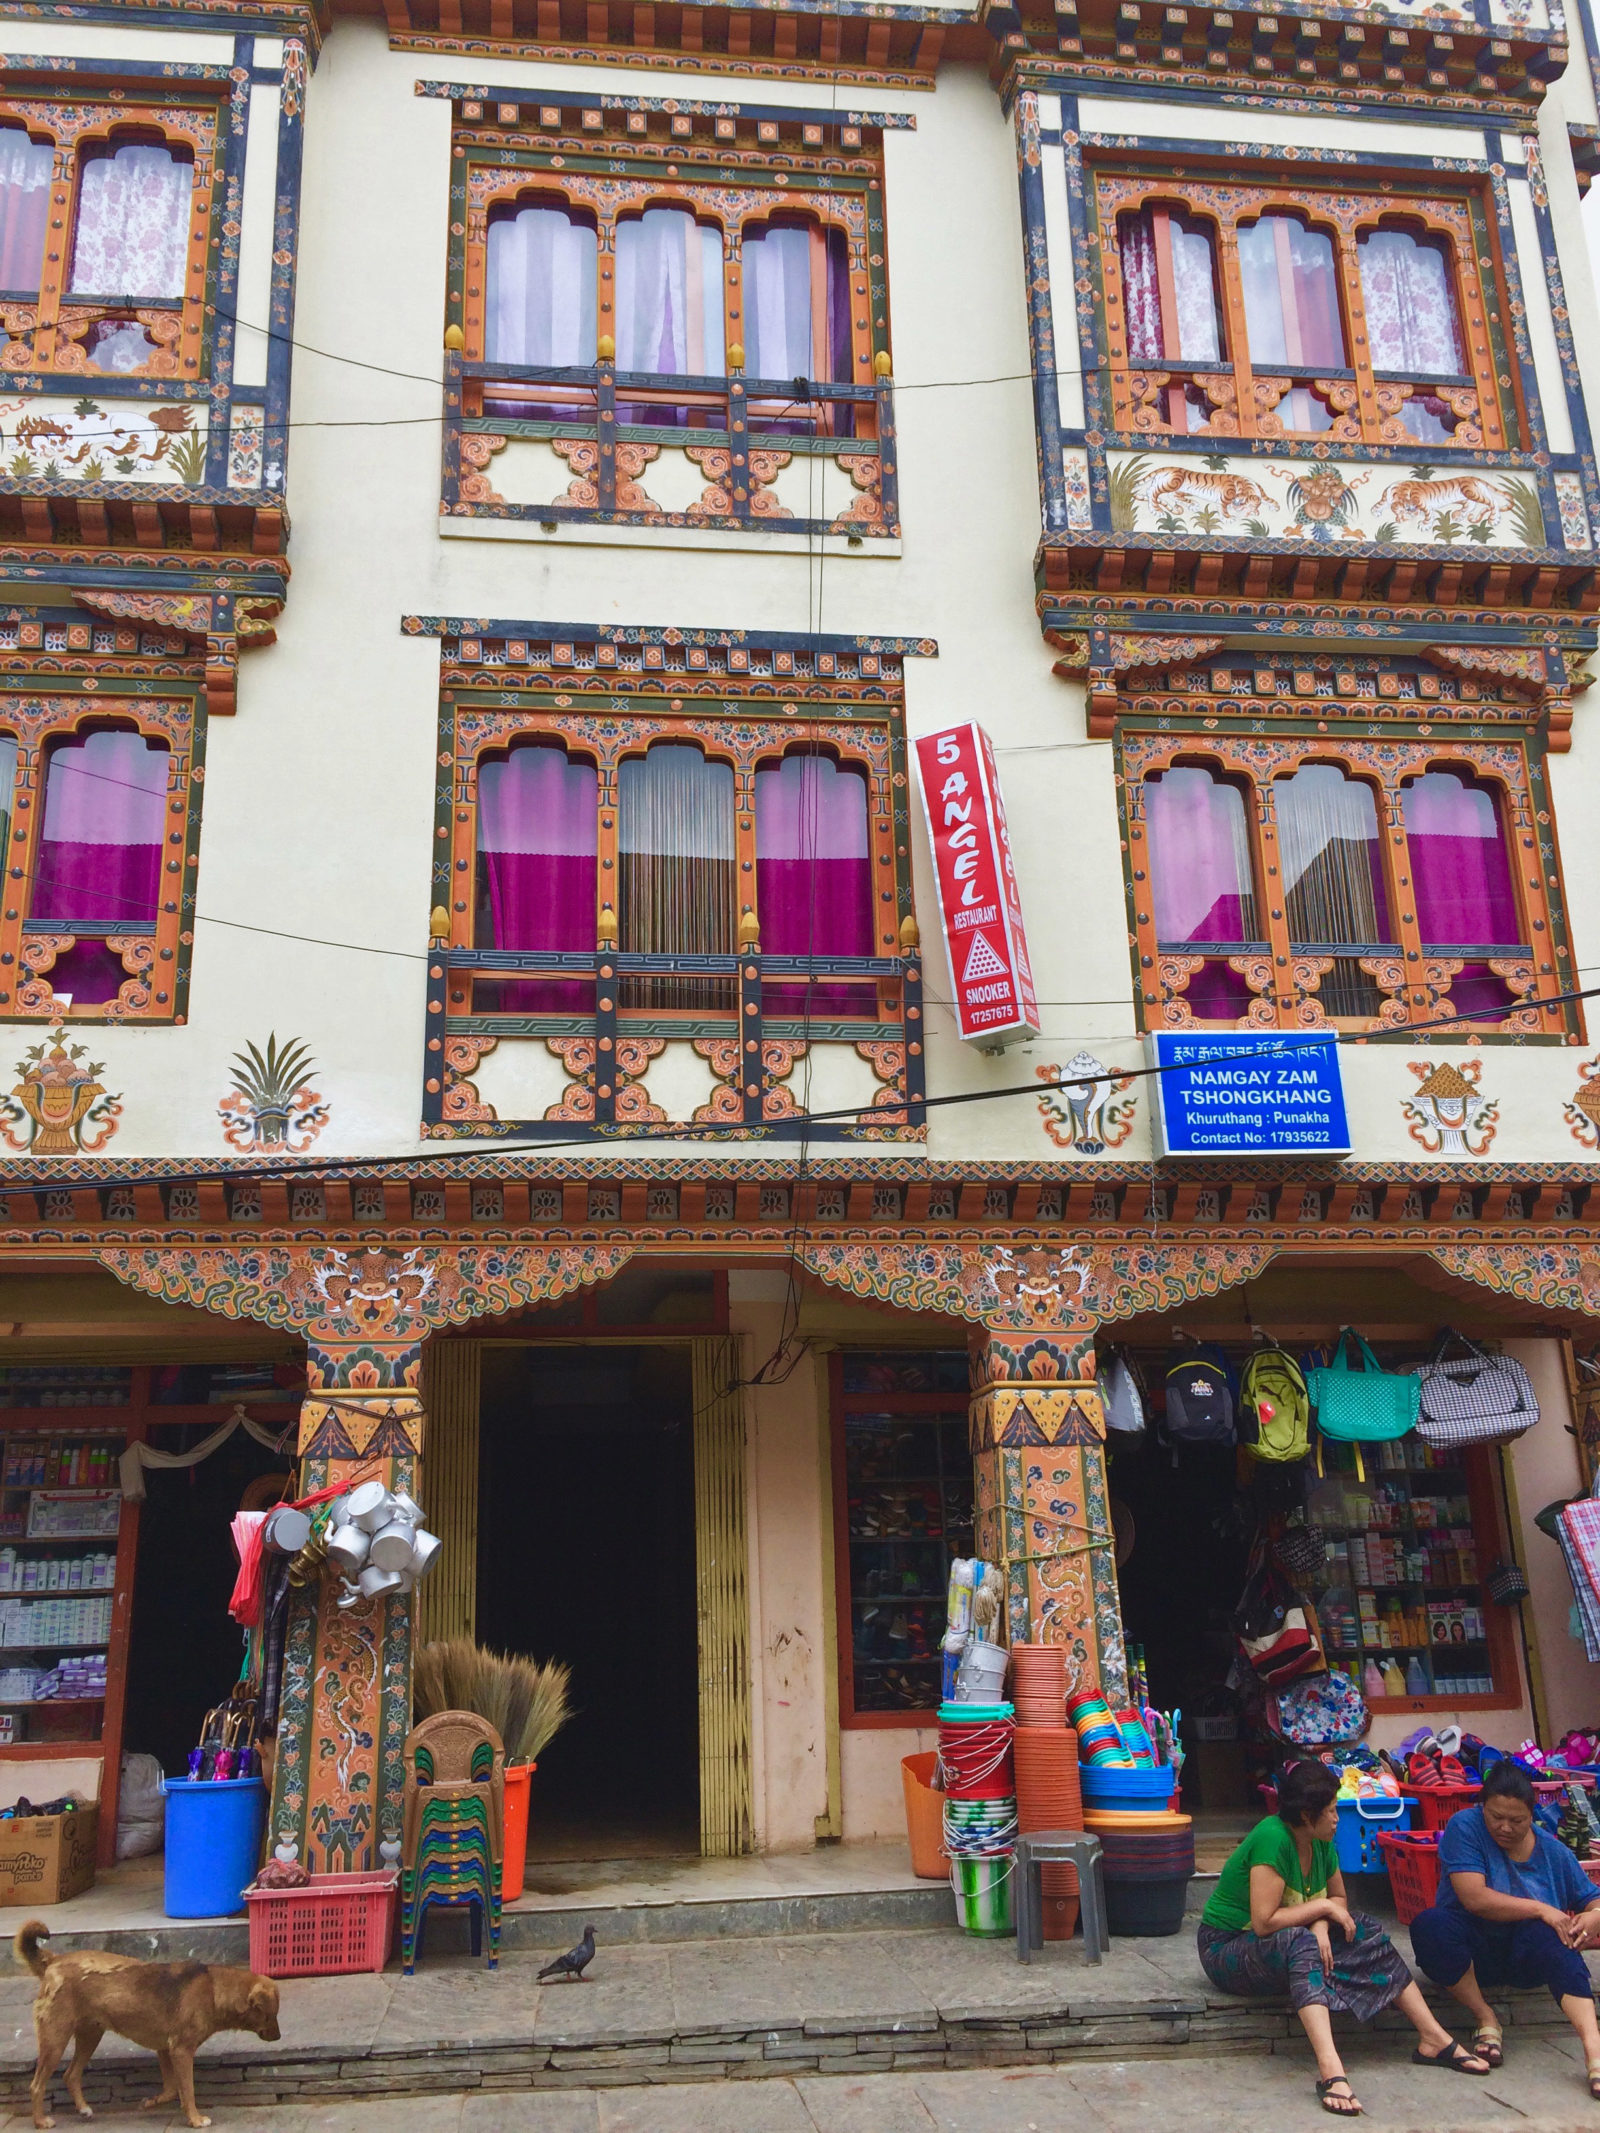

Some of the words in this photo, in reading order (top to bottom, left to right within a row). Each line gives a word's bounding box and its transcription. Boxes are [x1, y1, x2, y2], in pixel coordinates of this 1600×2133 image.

[936, 734, 961, 765] 5
[940, 771, 984, 906] ANGEL
[953, 905, 998, 930] RESTAURANT
[966, 981, 1011, 1006] SNOOKER
[970, 1005, 1013, 1024] 17257675
[1190, 1071, 1272, 1085] NAMGAY
[1276, 1070, 1318, 1084] ZAM
[1180, 1089, 1332, 1105] TSHONGKHANG
[1186, 1112, 1263, 1127] Khuruthang
[1273, 1111, 1330, 1124] Punakha
[1191, 1132, 1241, 1144] Contact
[1244, 1132, 1267, 1144] No:
[1270, 1131, 1330, 1143] 17935622
[14, 1871, 43, 1885] pants
